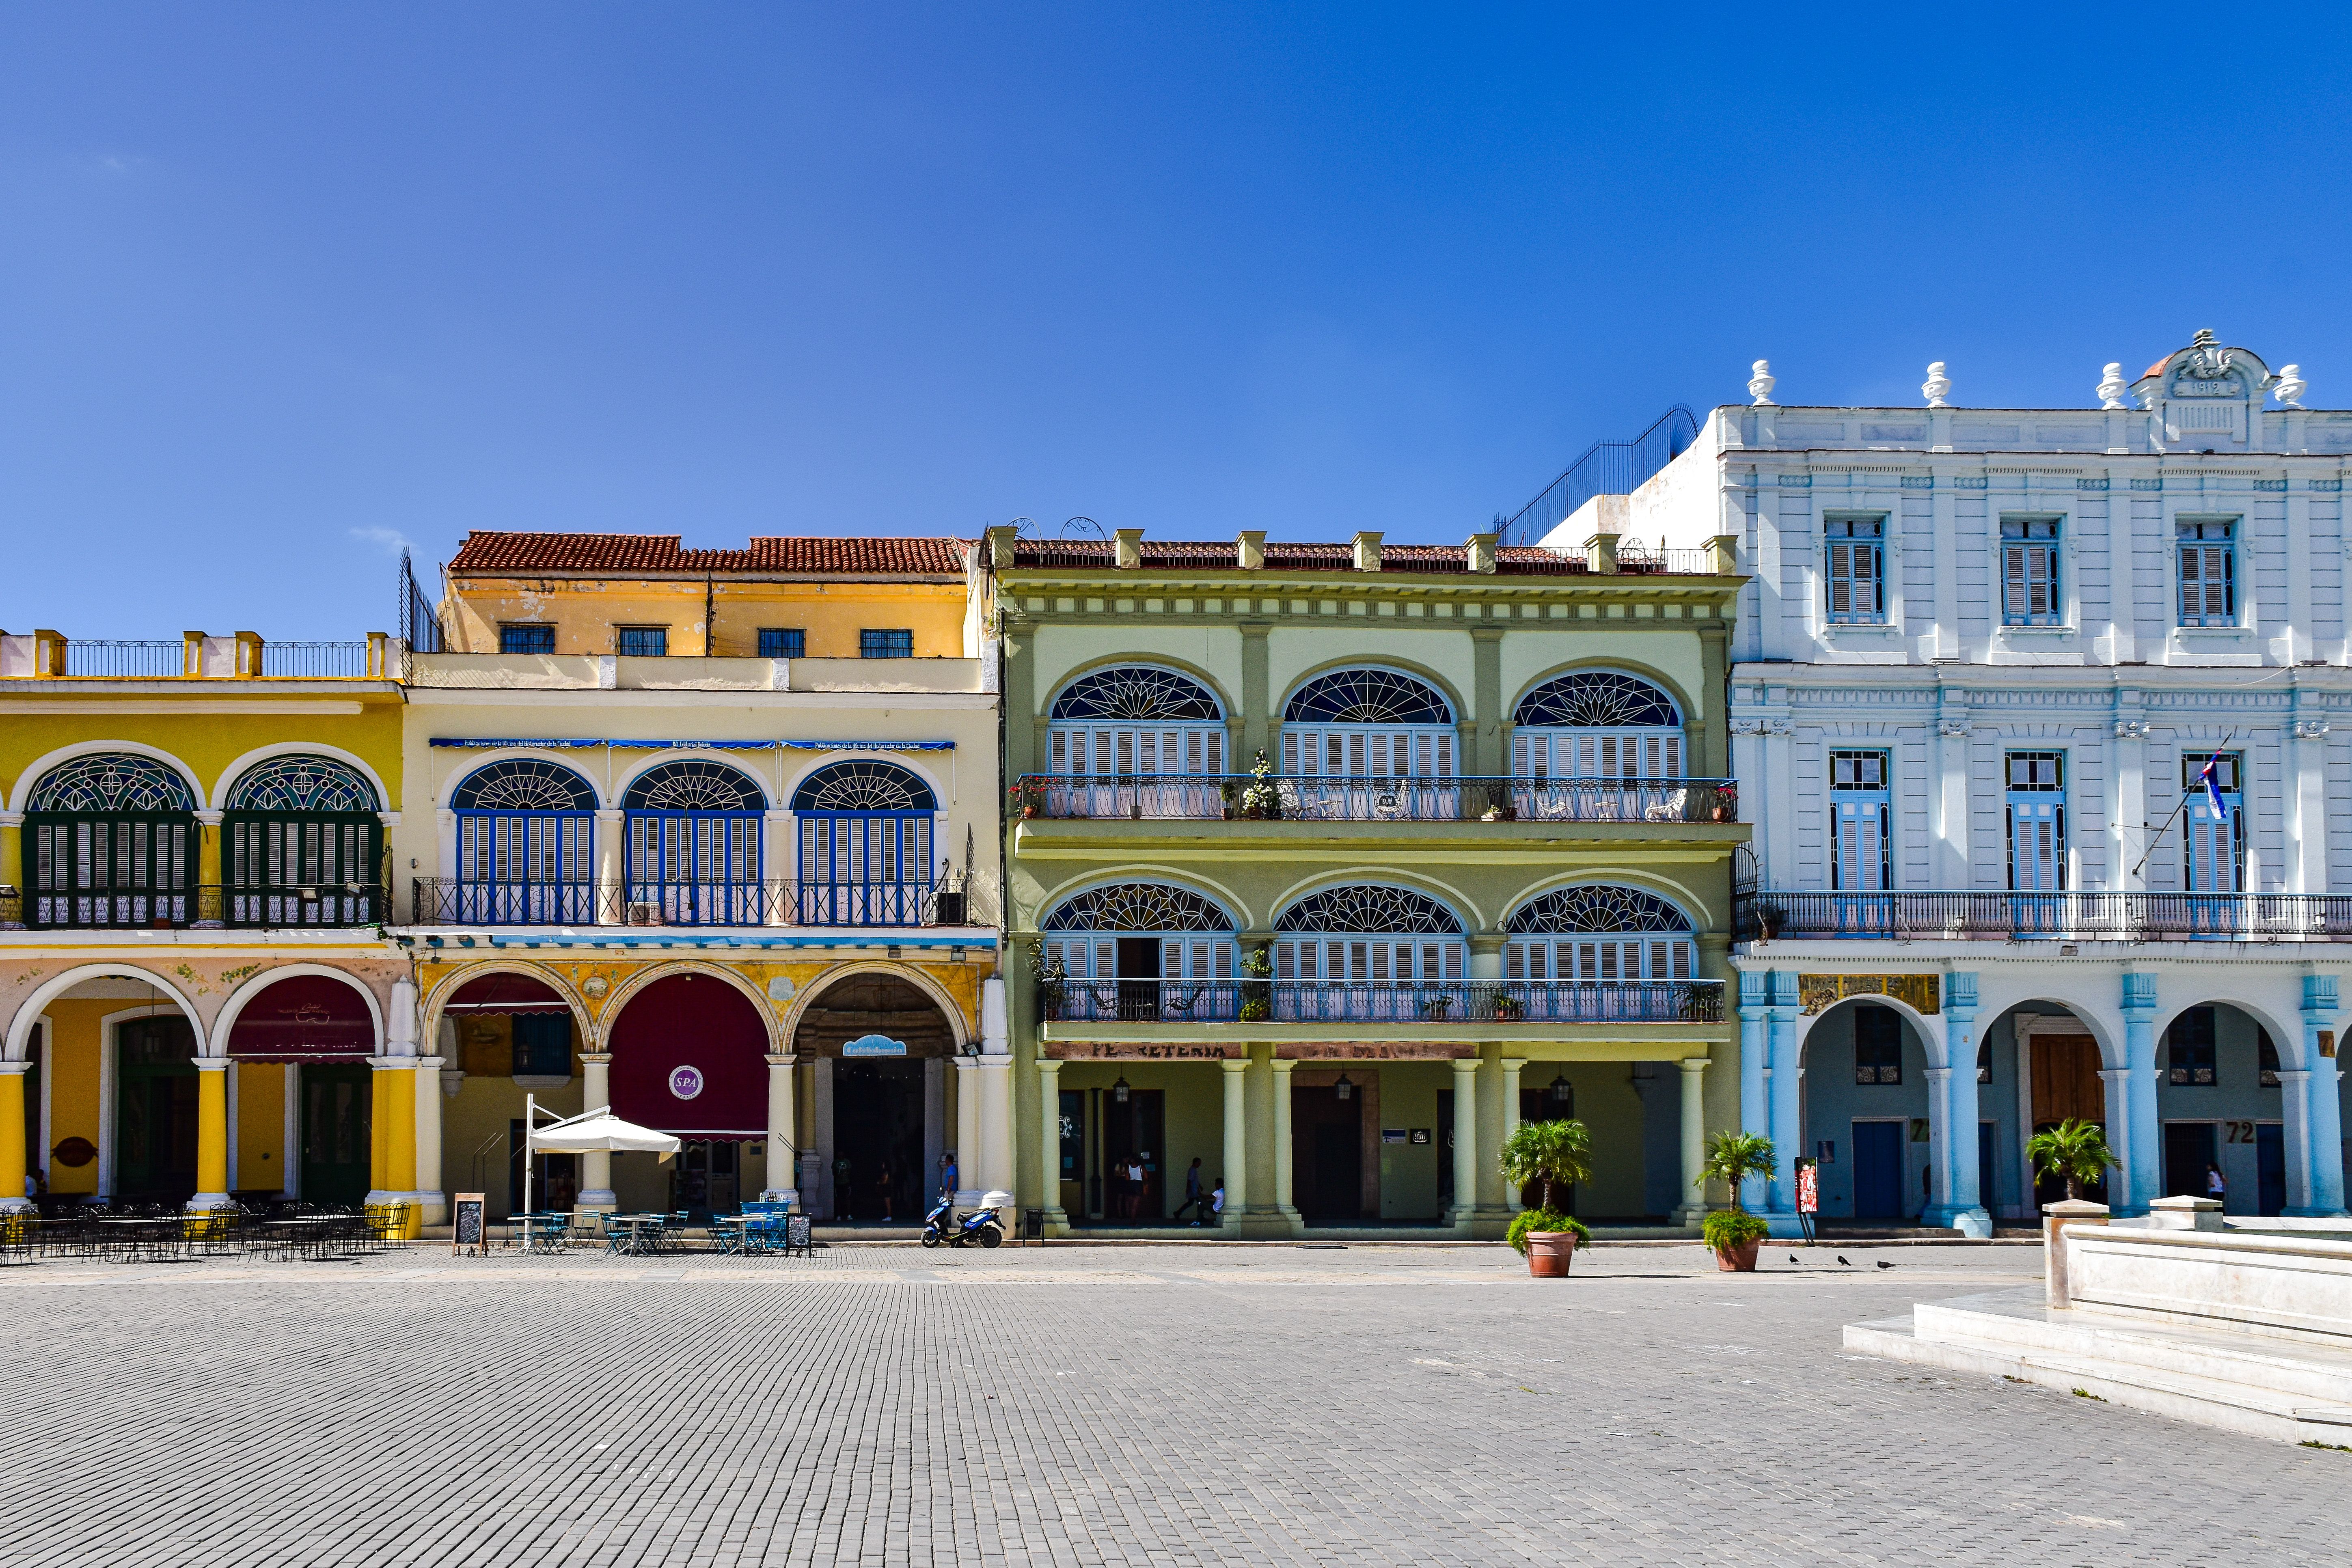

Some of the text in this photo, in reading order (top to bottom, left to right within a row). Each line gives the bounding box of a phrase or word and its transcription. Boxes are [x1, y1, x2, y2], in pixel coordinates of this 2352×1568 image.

[676, 1077, 696, 1087] SPA
[1913, 1118, 1930, 1141] 7
[2226, 1122, 2254, 1143] 72
